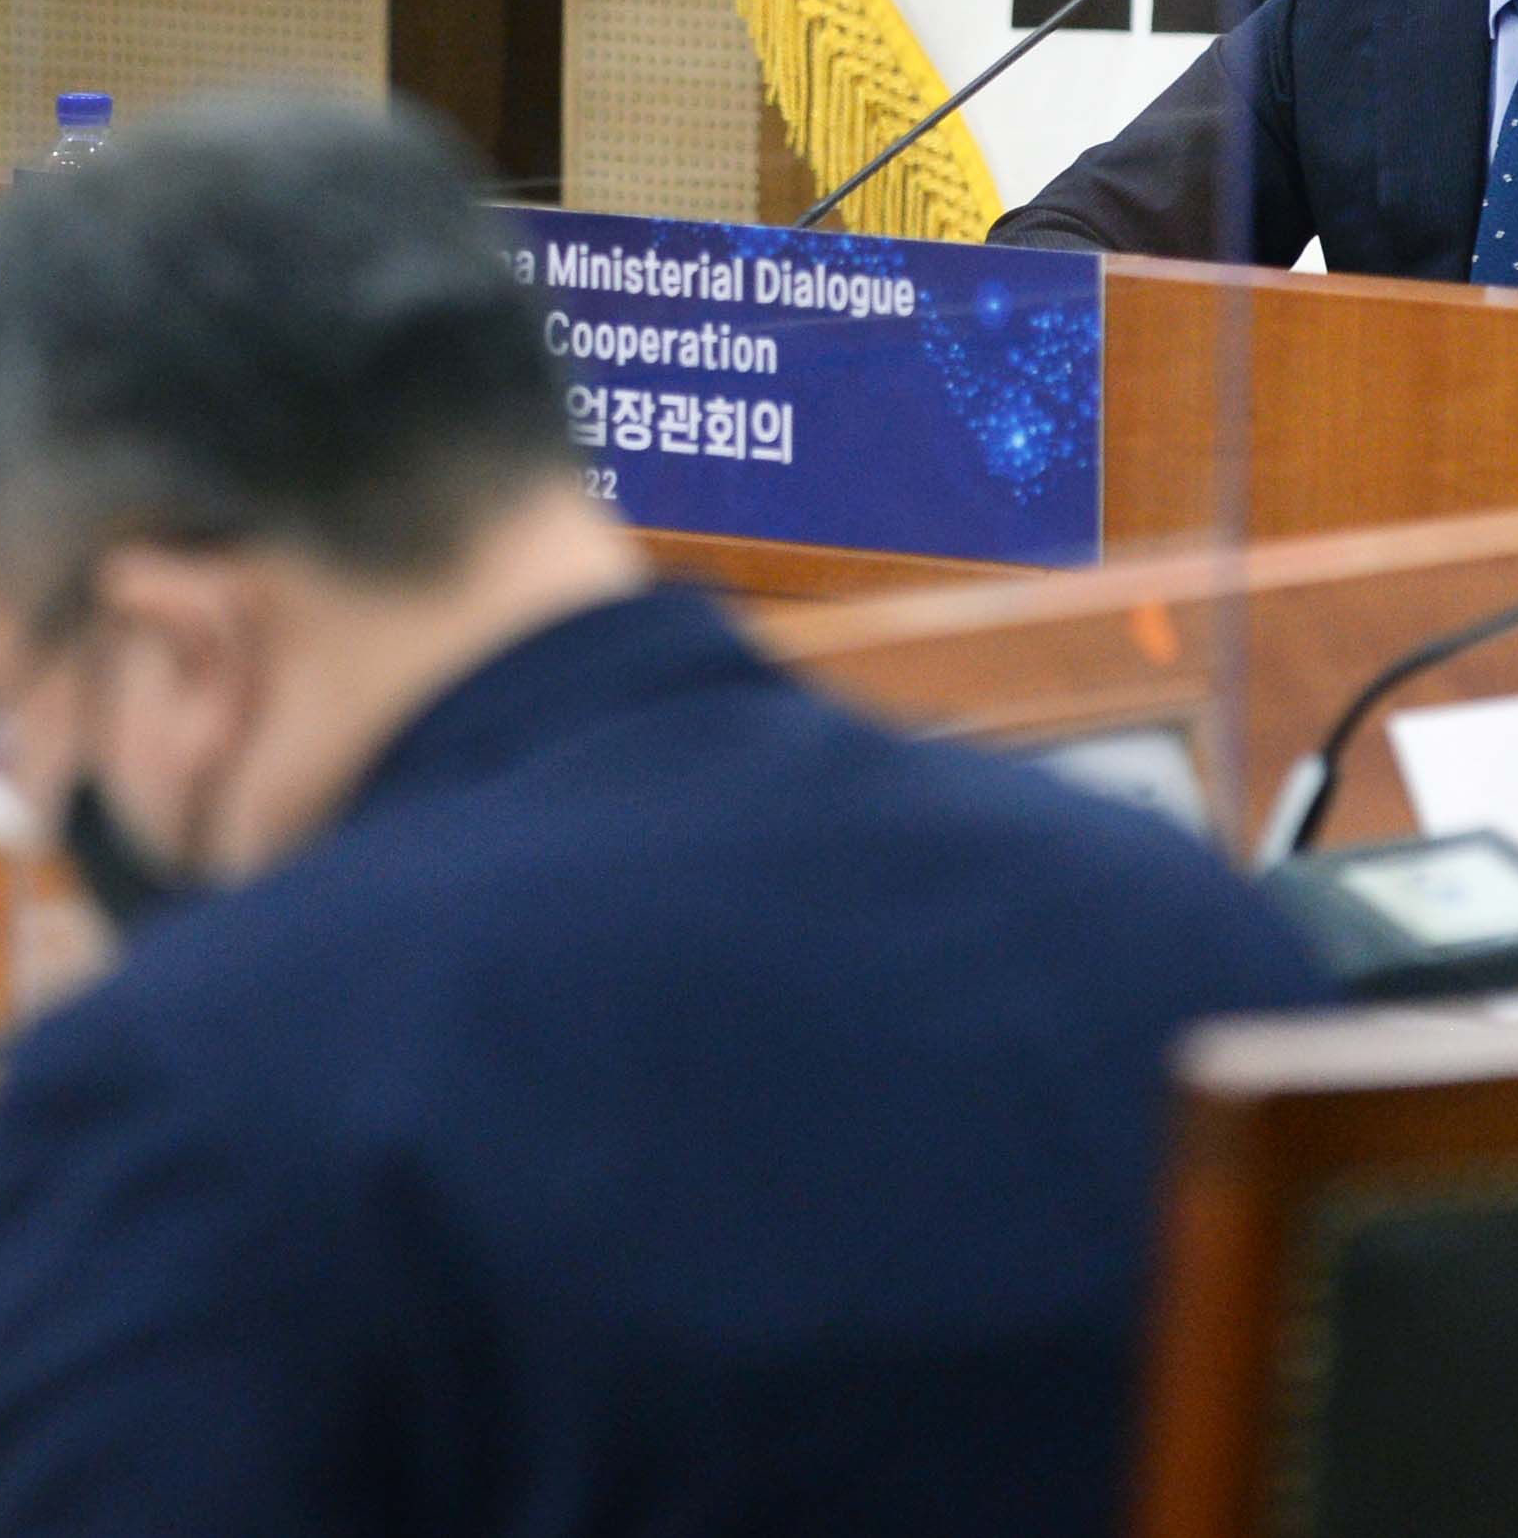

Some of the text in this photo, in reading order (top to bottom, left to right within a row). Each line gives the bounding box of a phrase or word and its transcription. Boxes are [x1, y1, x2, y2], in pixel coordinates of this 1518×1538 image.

[546, 241, 744, 302] Ministerial
[755, 258, 915, 318] Dialogue
[544, 310, 778, 374] Cooperation
[566, 384, 793, 465] 업장관회의
